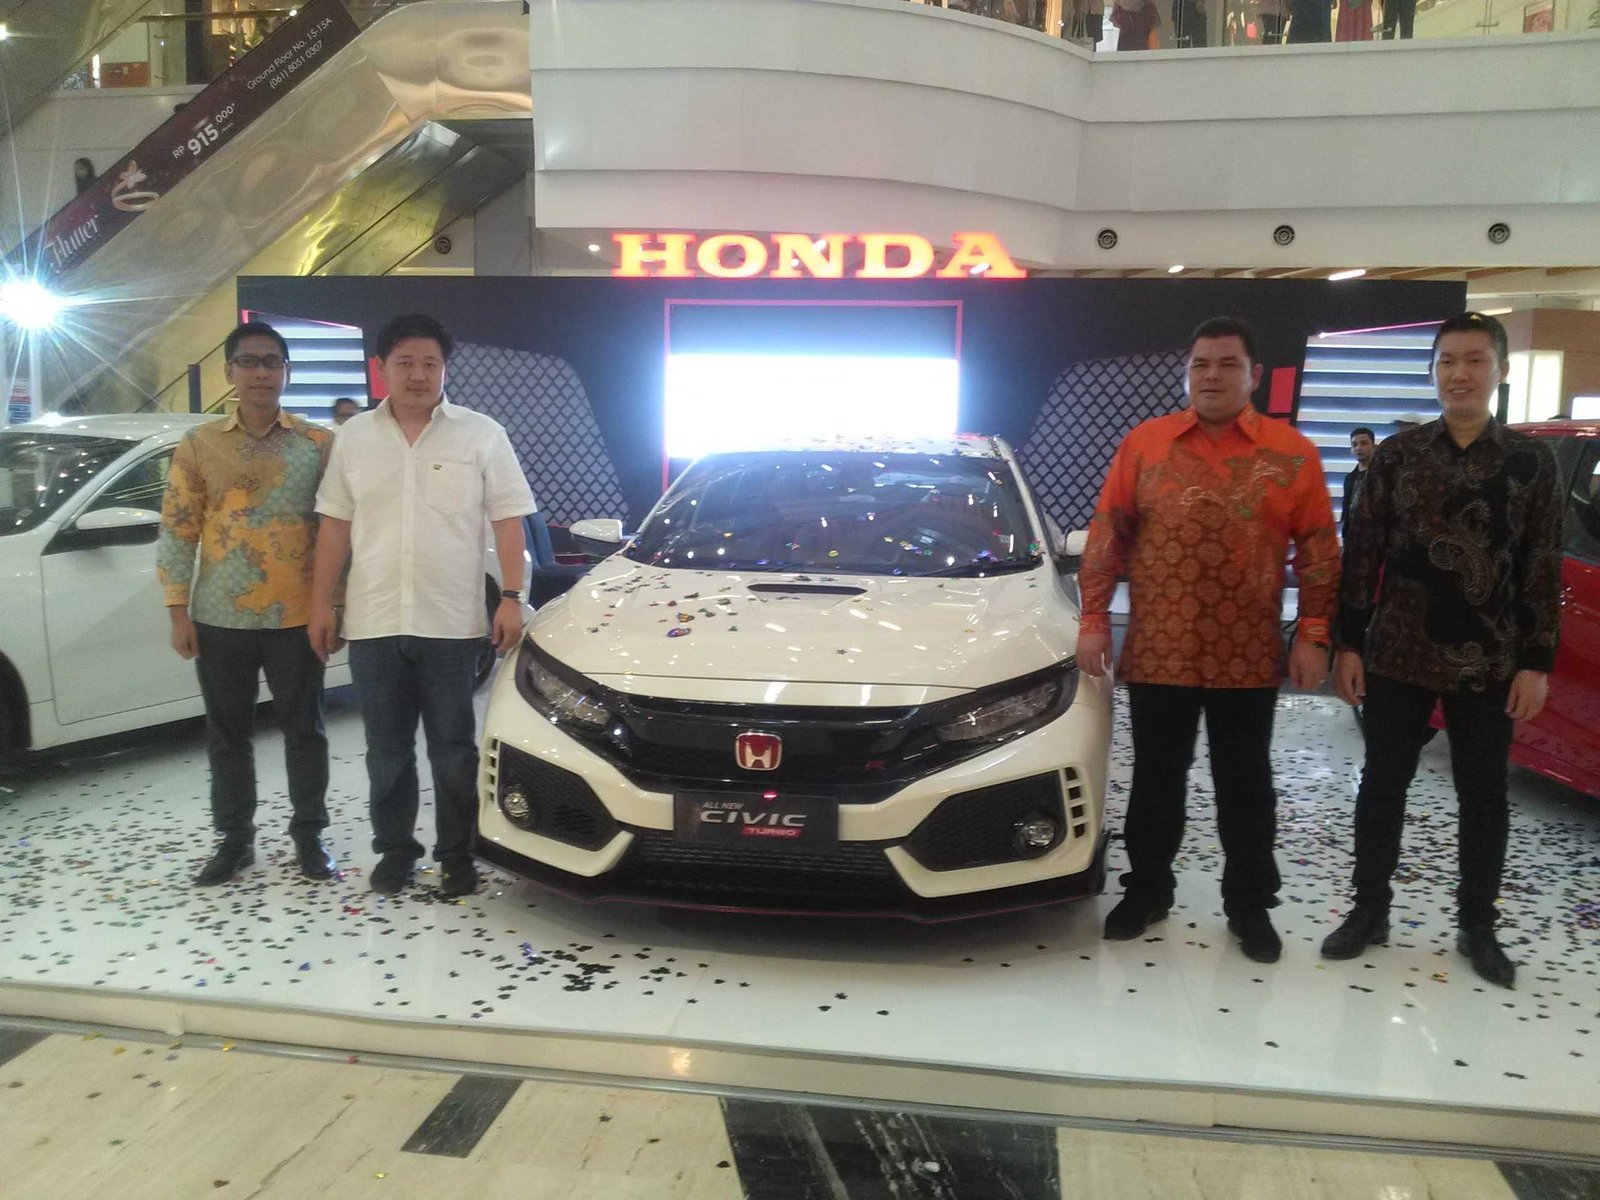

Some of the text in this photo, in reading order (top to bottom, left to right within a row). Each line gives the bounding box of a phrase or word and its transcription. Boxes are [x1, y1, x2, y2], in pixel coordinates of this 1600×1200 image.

[247, 65, 275, 89] Ground
[274, 50, 292, 67] Floor
[307, 17, 333, 40] 15-15A
[269, 40, 323, 89] (061) 8051 0307
[172, 145, 185, 159] RP
[611, 233, 1027, 278] HONDA
[722, 802, 744, 810] NEW
[700, 810, 807, 827] CIVIC
[746, 827, 797, 836] TURBO
